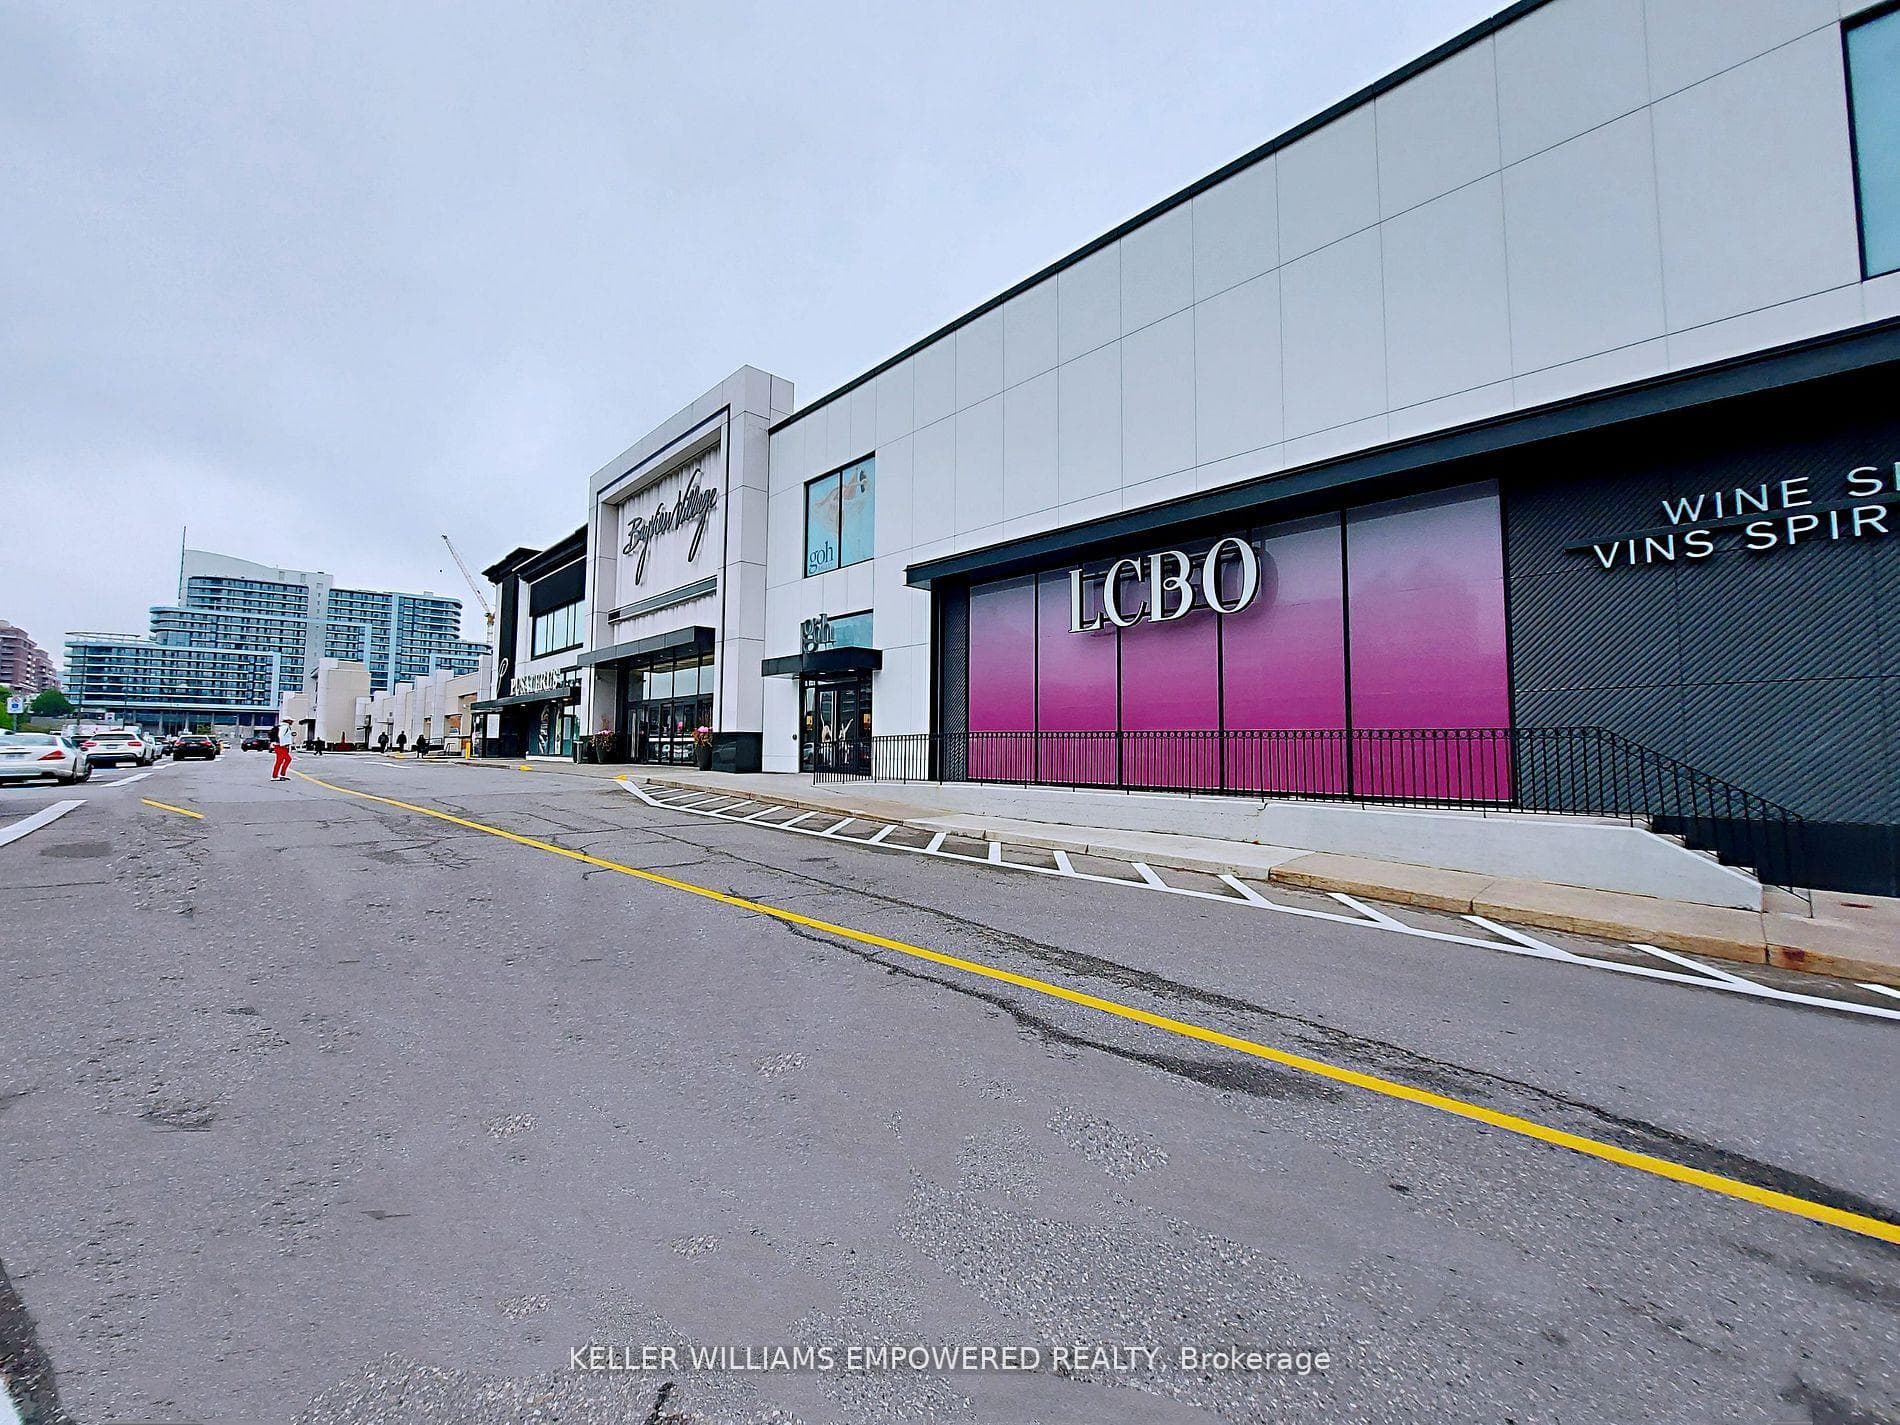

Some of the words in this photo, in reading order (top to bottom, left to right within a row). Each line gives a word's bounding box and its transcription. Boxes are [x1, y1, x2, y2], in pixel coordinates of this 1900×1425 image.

[674, 468, 718, 562] Village
[1661, 476, 1813, 525] WINE
[1846, 462, 1900, 497] S
[808, 540, 834, 574] goh
[1593, 529, 1714, 568] VINS
[1745, 505, 1889, 550] SPIR
[1068, 537, 1261, 633] LCBO
